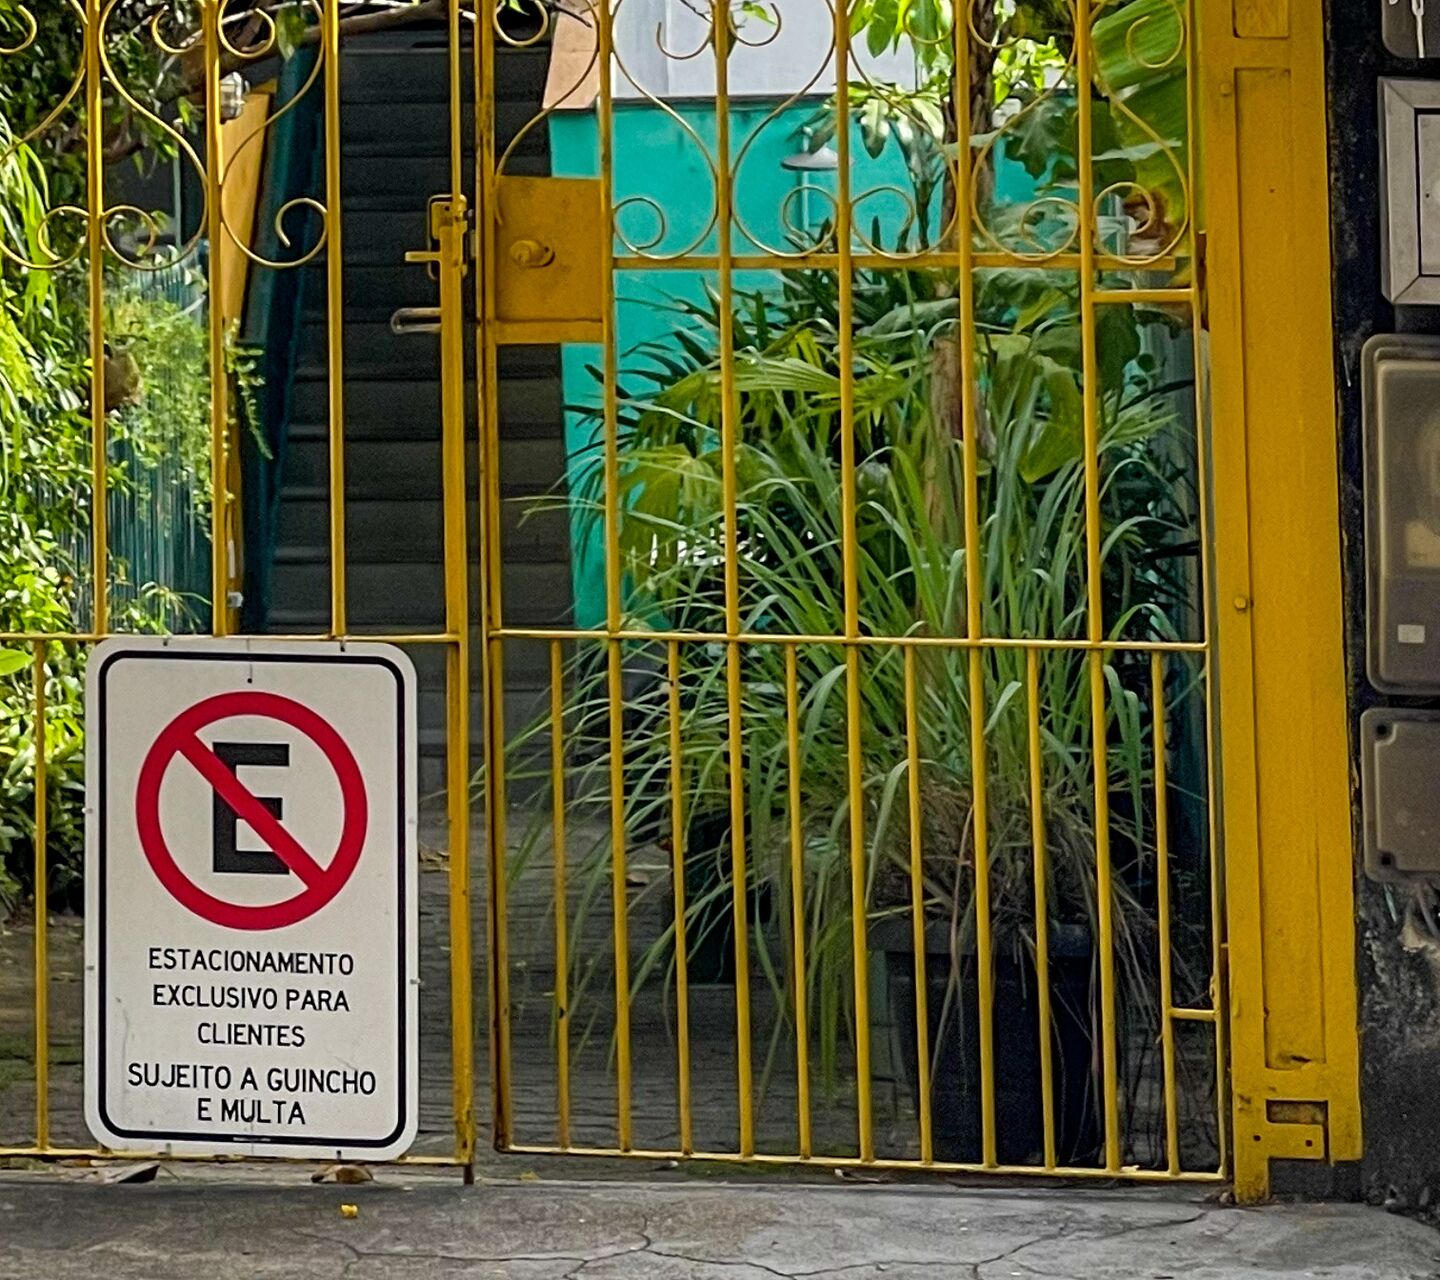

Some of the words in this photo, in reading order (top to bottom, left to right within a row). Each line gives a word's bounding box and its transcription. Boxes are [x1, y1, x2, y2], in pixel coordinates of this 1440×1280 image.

[148, 947, 354, 976] ESTACIONAMENTO
[153, 984, 278, 1010] EXCLUSIVO
[286, 988, 350, 1013] PARA
[197, 1022, 305, 1048] CLIENTES
[128, 1062, 232, 1090] SUJEITO
[240, 1067, 259, 1091] A
[267, 1067, 376, 1095] GUINCHO
[197, 1097, 213, 1122] E
[221, 1098, 306, 1125] MULTA
